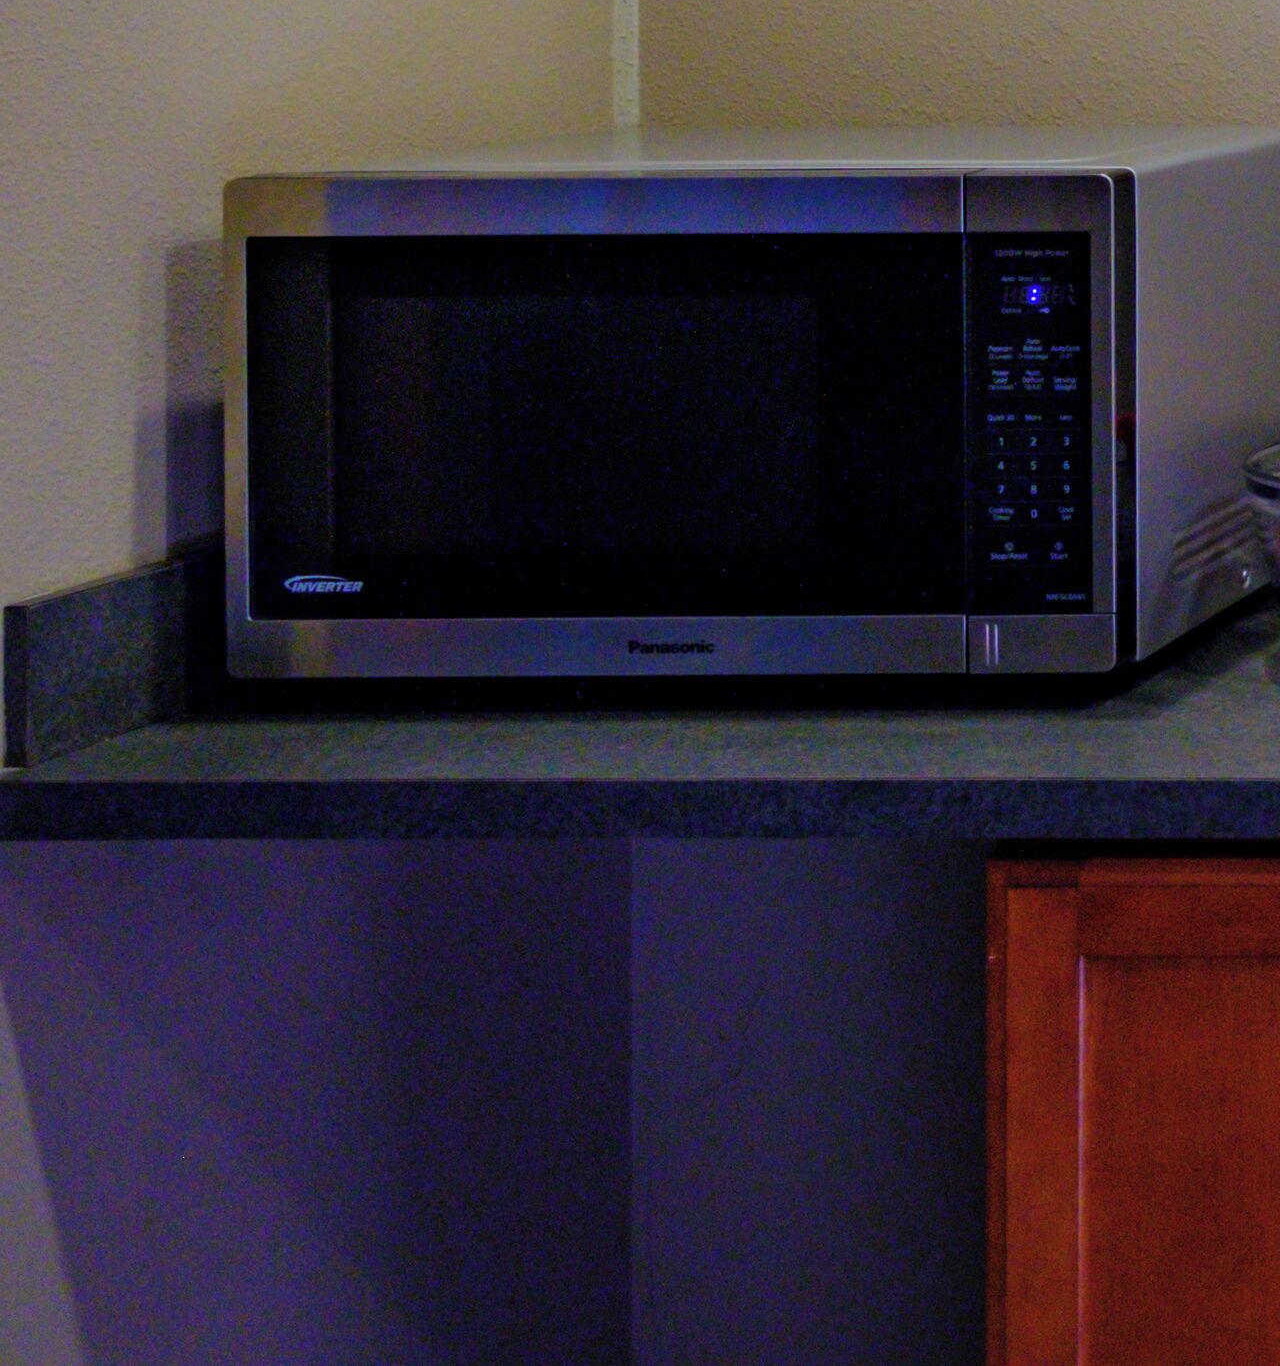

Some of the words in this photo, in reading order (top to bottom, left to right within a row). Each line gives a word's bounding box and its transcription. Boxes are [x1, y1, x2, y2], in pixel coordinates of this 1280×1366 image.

[998, 436, 1004, 447] 1
[1030, 437, 1038, 447] 2
[1062, 437, 1070, 447] 3
[997, 460, 1005, 470] 4
[1030, 460, 1038, 470] 5
[1062, 460, 1070, 470] 6
[997, 484, 1005, 494] 7
[1030, 484, 1038, 494] 8
[1062, 484, 1070, 494] 9
[1030, 509, 1038, 519] 0
[1049, 552, 1069, 560] Start
[291, 581, 364, 593] INVERTER
[627, 640, 715, 654] Panasonic
